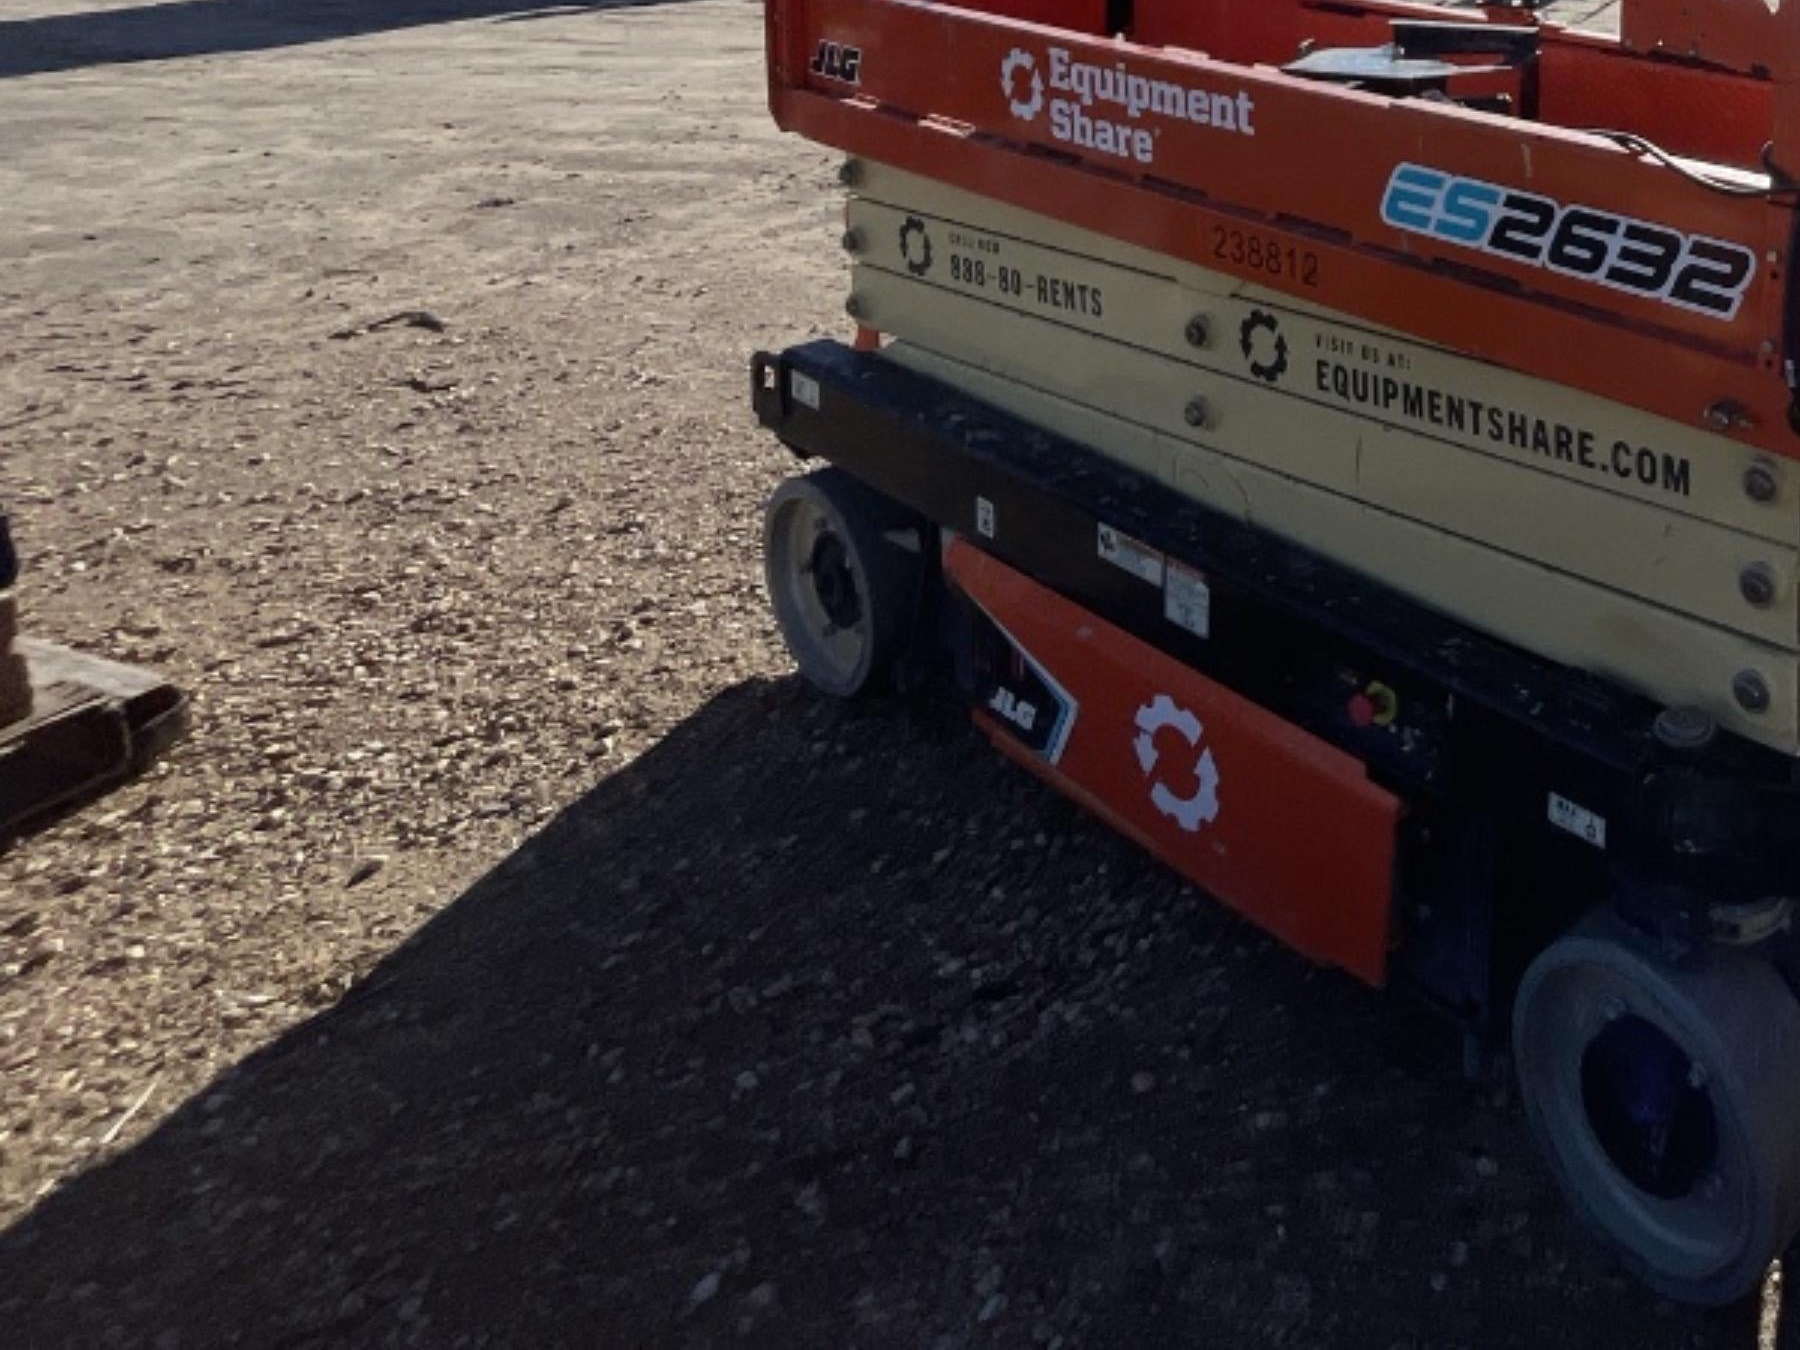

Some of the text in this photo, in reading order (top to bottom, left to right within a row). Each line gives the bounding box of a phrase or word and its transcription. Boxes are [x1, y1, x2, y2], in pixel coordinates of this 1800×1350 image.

[808, 39, 862, 86] JLG
[1047, 47, 1255, 136] Equipment
[1051, 98, 1153, 163] Share
[1214, 223, 1319, 288] 238812
[1380, 162, 1755, 321] ES2632
[950, 254, 1103, 318] 888-80-RENTS
[1316, 358, 1692, 497] EQUIPMENTSHARE.COM
[990, 686, 1038, 730] JLG
